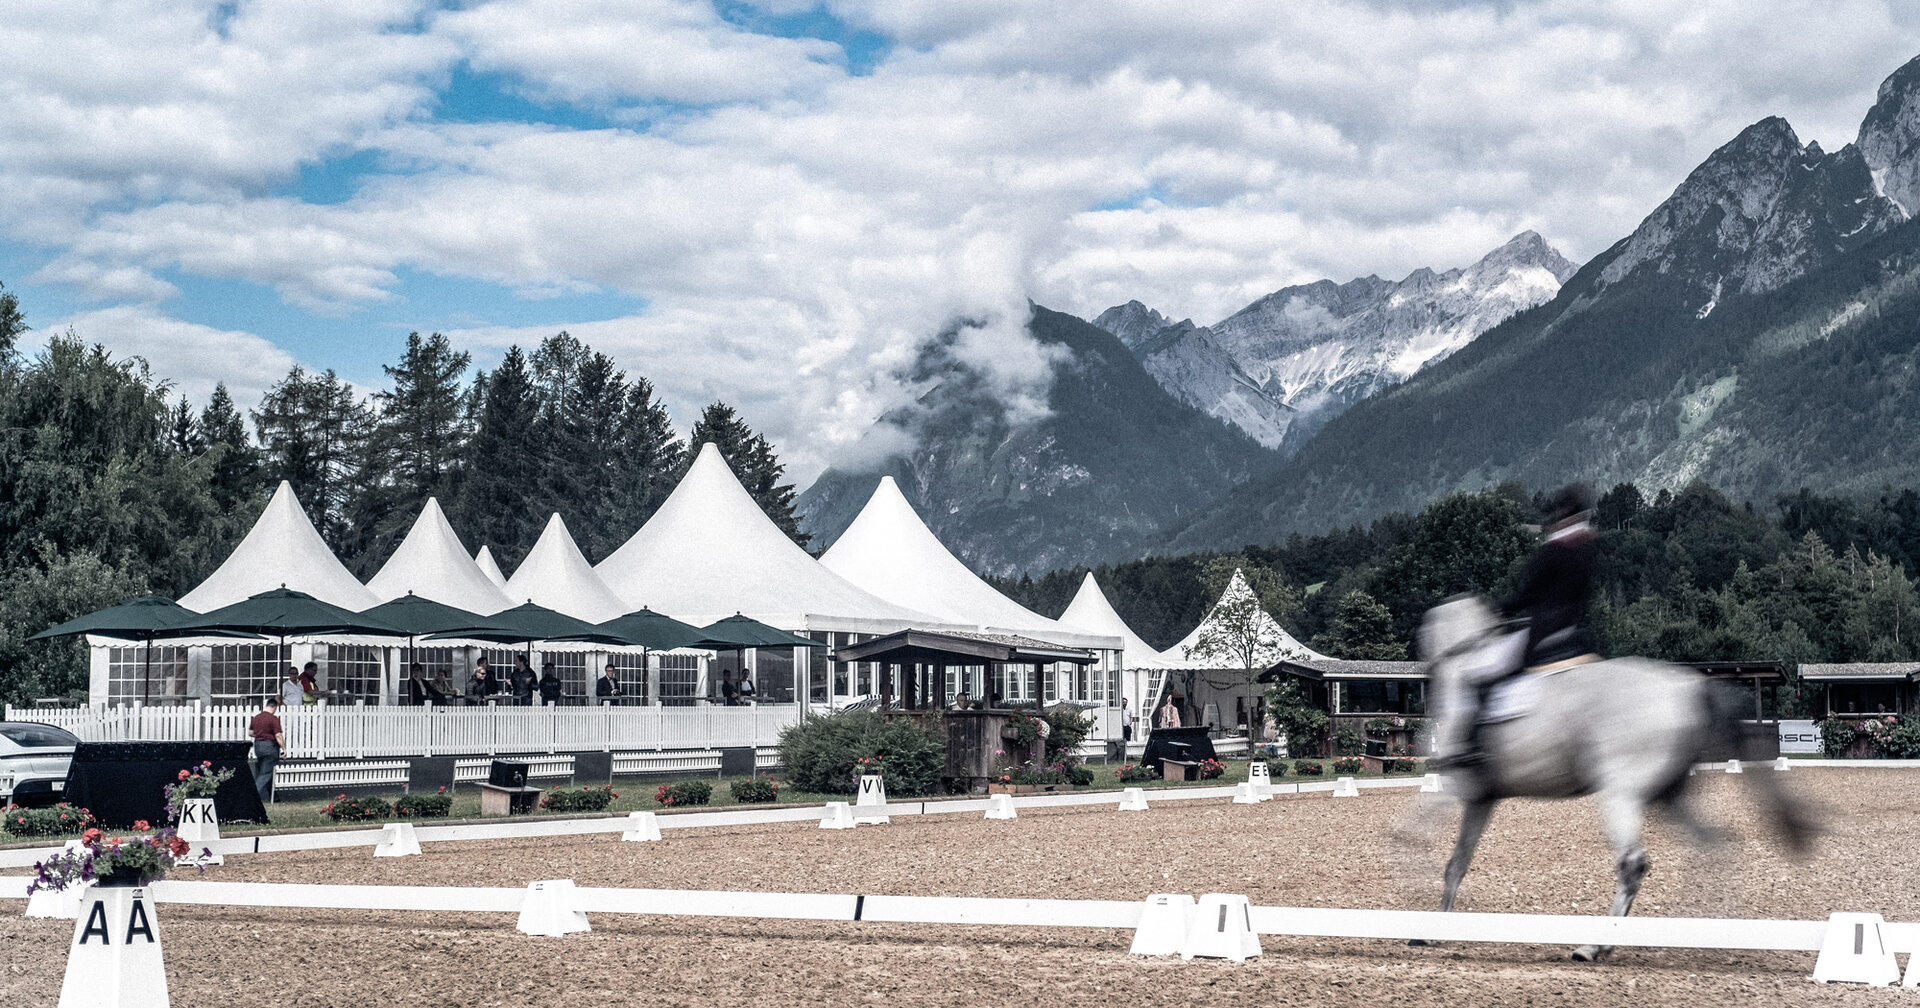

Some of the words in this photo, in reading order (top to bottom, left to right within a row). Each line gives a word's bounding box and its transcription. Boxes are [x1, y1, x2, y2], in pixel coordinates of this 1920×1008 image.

[1252, 765, 1260, 776] E
[862, 779, 873, 793] V
[875, 779, 882, 793] V
[182, 804, 197, 823] K
[202, 804, 214, 823] K
[79, 900, 110, 945] A
[125, 899, 155, 945] A
